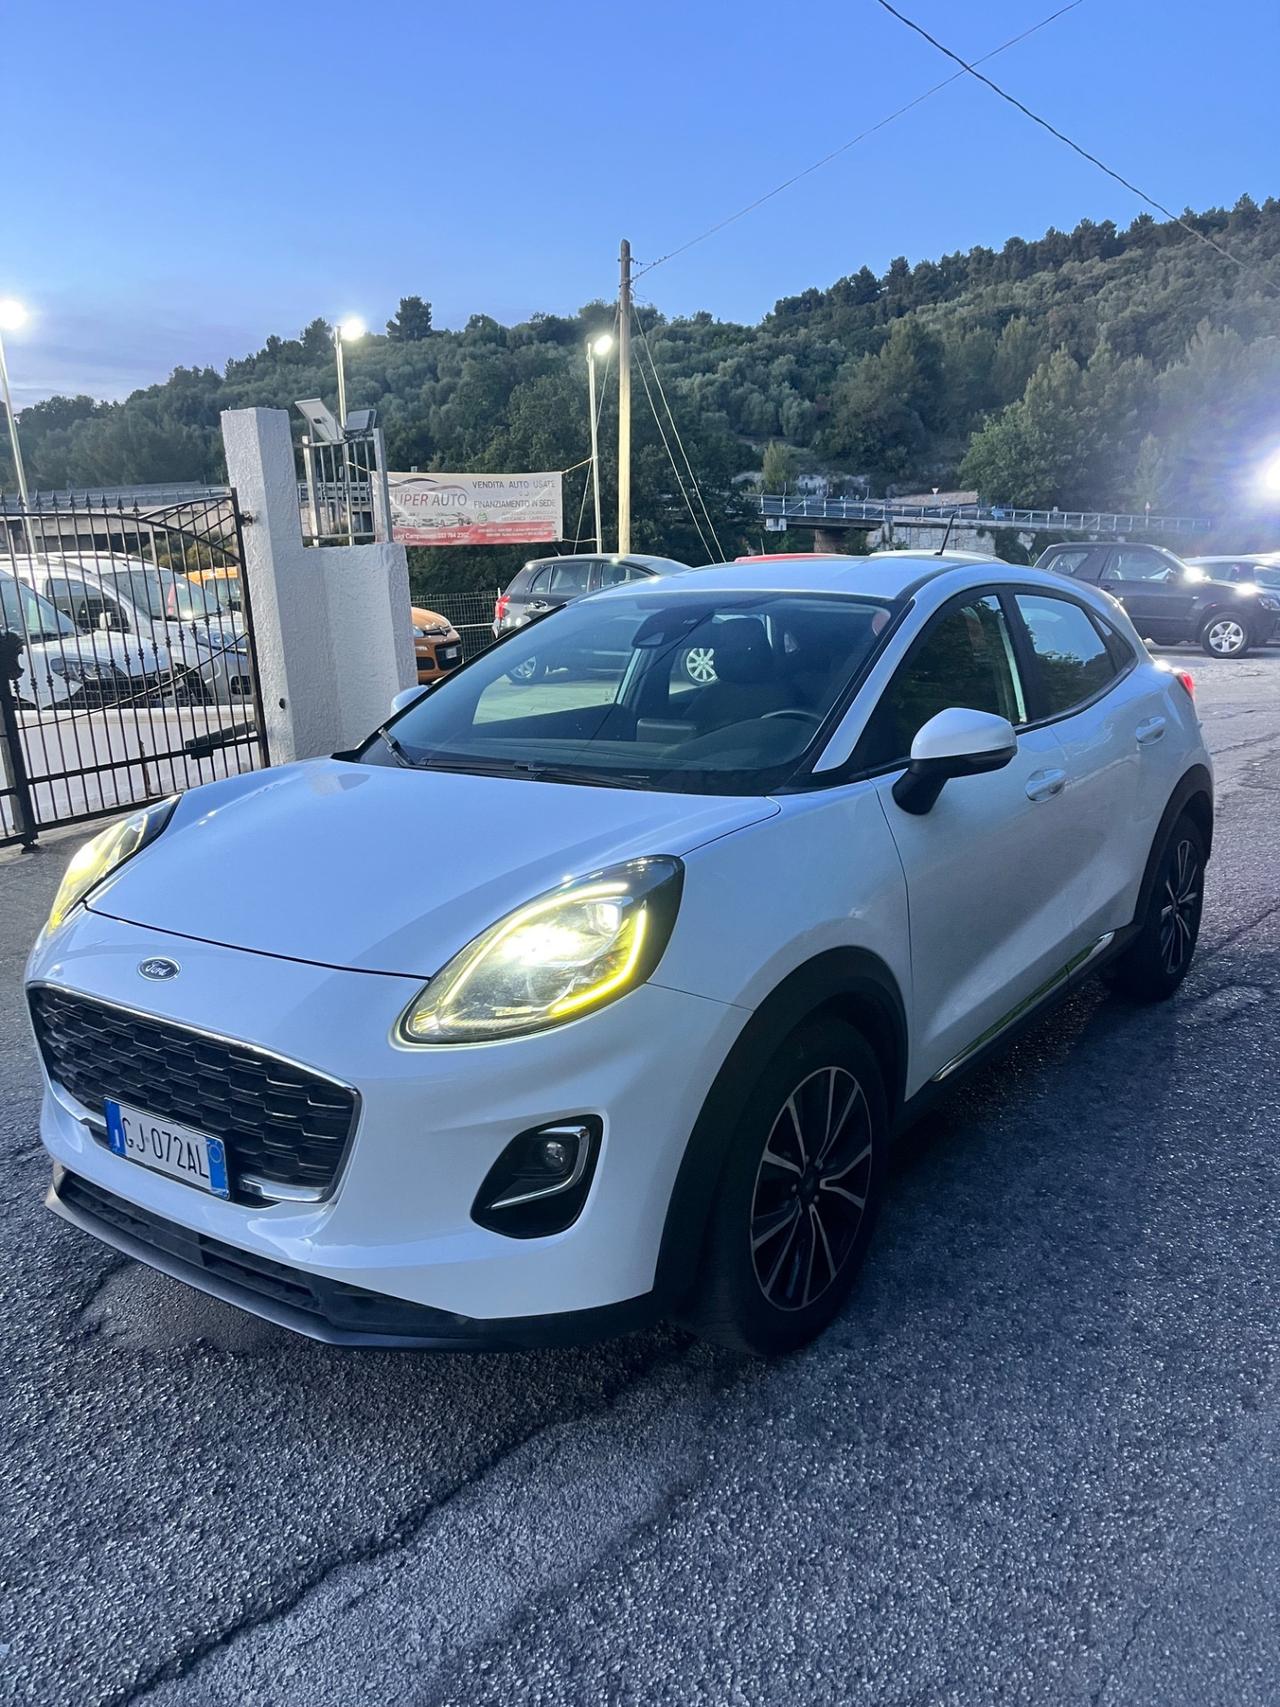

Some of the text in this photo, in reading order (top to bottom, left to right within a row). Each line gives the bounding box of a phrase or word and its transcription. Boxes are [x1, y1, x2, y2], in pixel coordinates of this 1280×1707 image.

[472, 480, 556, 489] VENDITA AUTO USATE
[432, 493, 467, 506] AUTO
[473, 499, 530, 509] FINANZIAMENTO
[539, 499, 556, 508] SEDE
[145, 960, 171, 976] Ford
